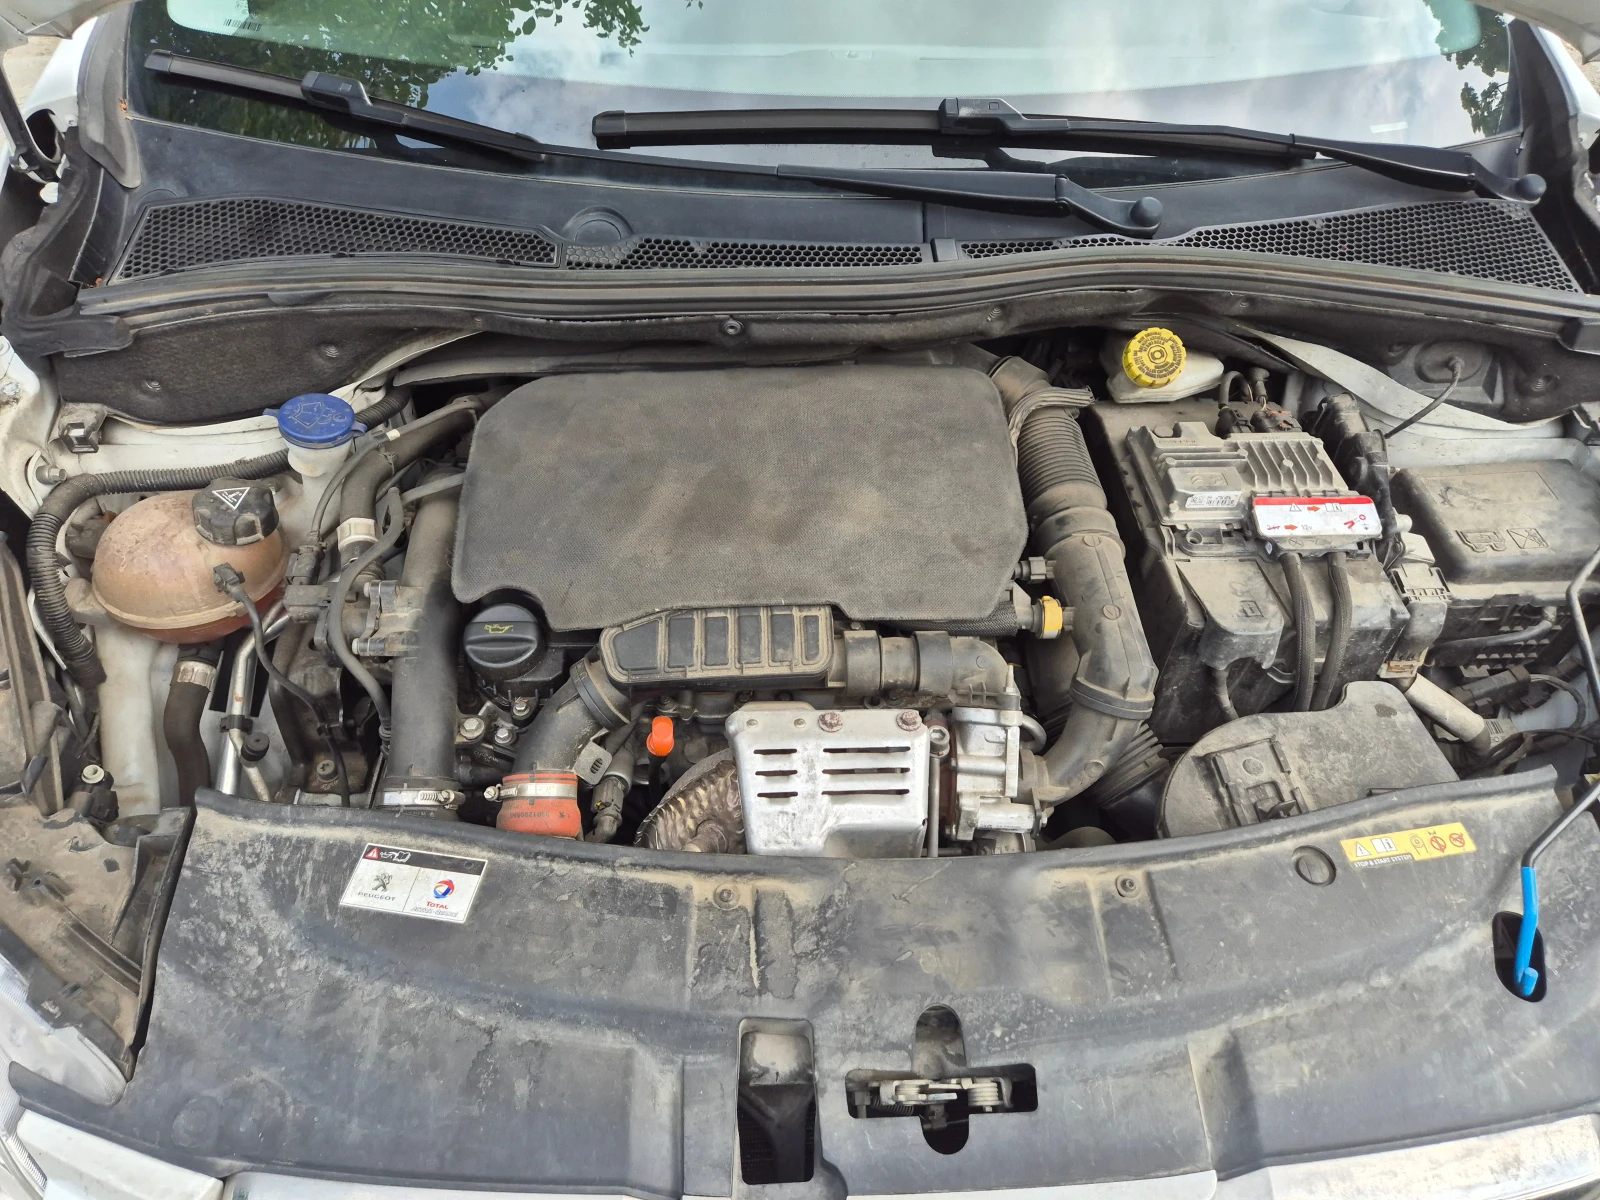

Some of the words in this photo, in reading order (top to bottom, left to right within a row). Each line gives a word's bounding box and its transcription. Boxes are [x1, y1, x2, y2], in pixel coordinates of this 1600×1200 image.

[1353, 860, 1368, 868] STOP
[1373, 857, 1391, 865] START
[1390, 854, 1412, 862] SYSTEM
[357, 891, 396, 901] PEUGEOT
[426, 901, 449, 909] TOTAL
